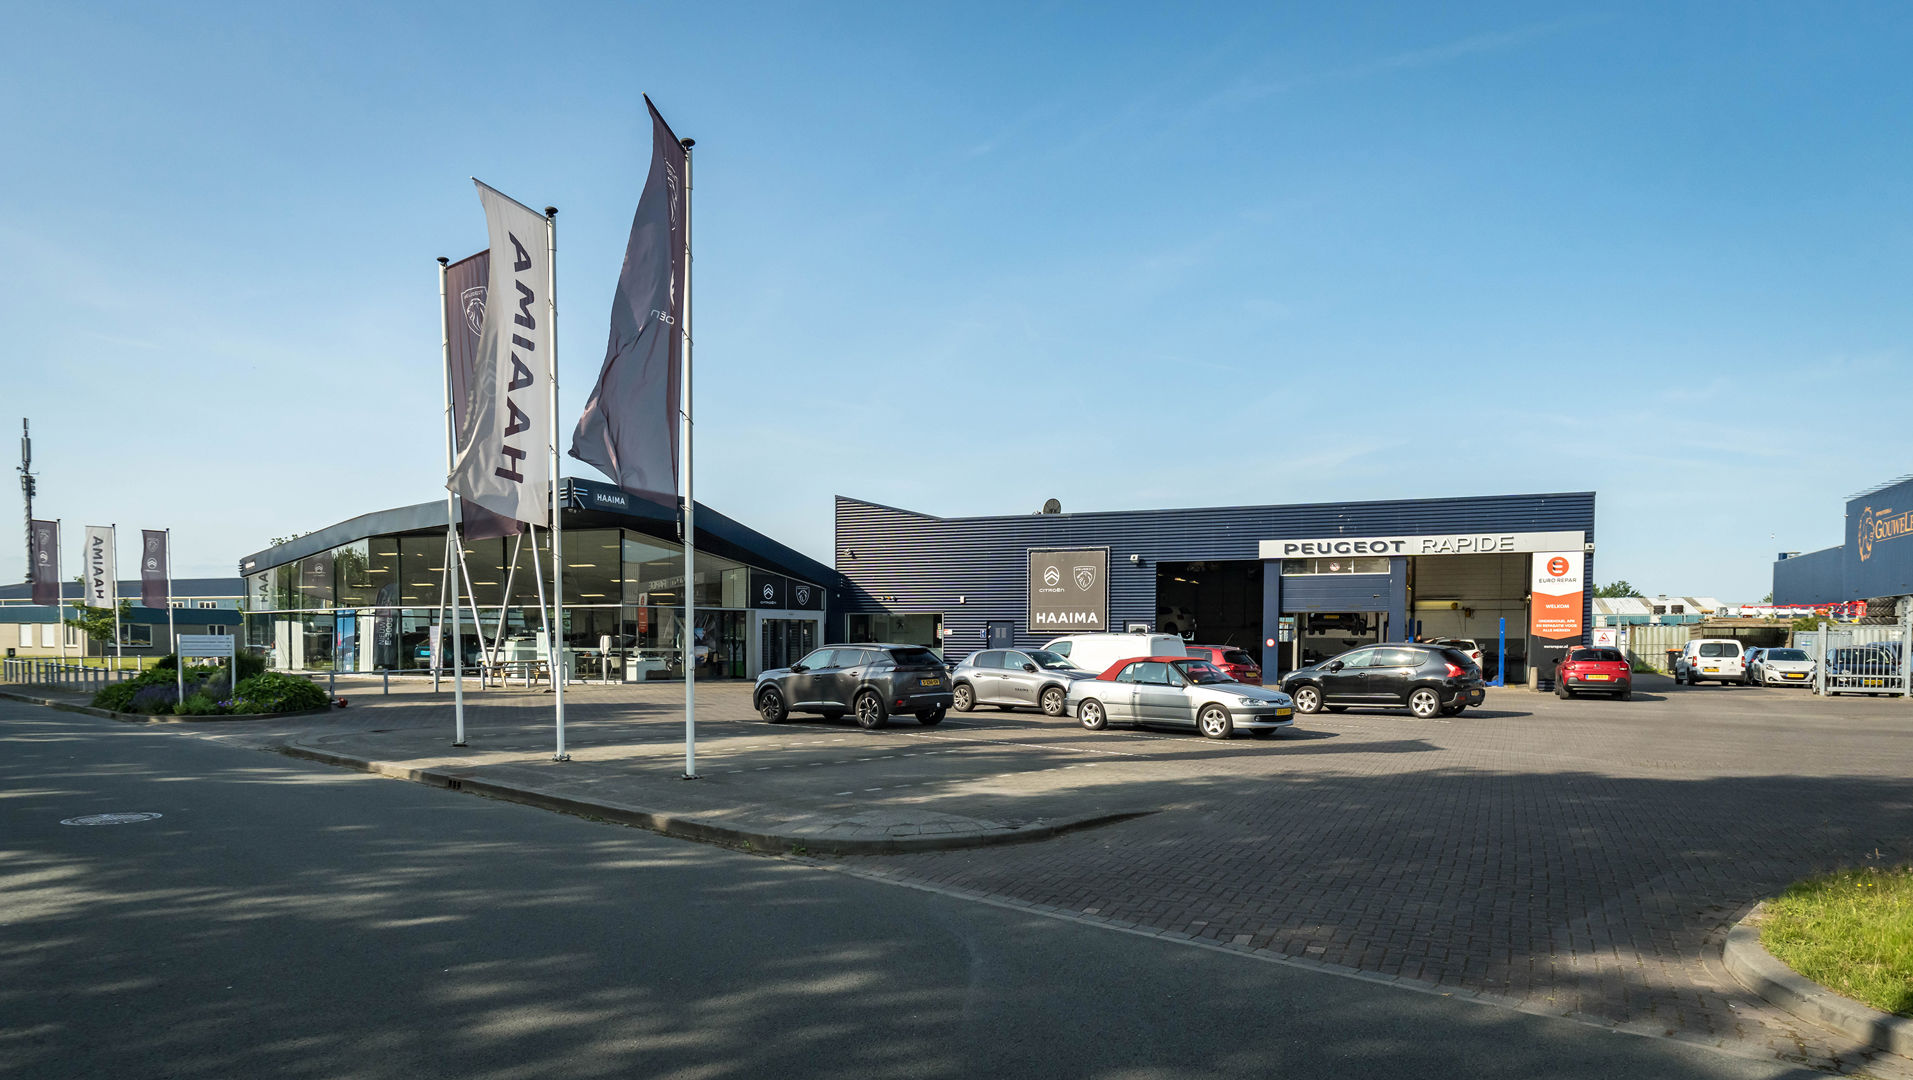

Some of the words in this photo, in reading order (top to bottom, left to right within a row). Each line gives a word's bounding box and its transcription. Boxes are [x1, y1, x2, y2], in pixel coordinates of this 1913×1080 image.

[596, 493, 626, 505] HAAIMA
[1283, 540, 1406, 556] PEUGEOT
[1421, 535, 1515, 554] RAPIDE
[1036, 612, 1099, 624] HAAIMA
